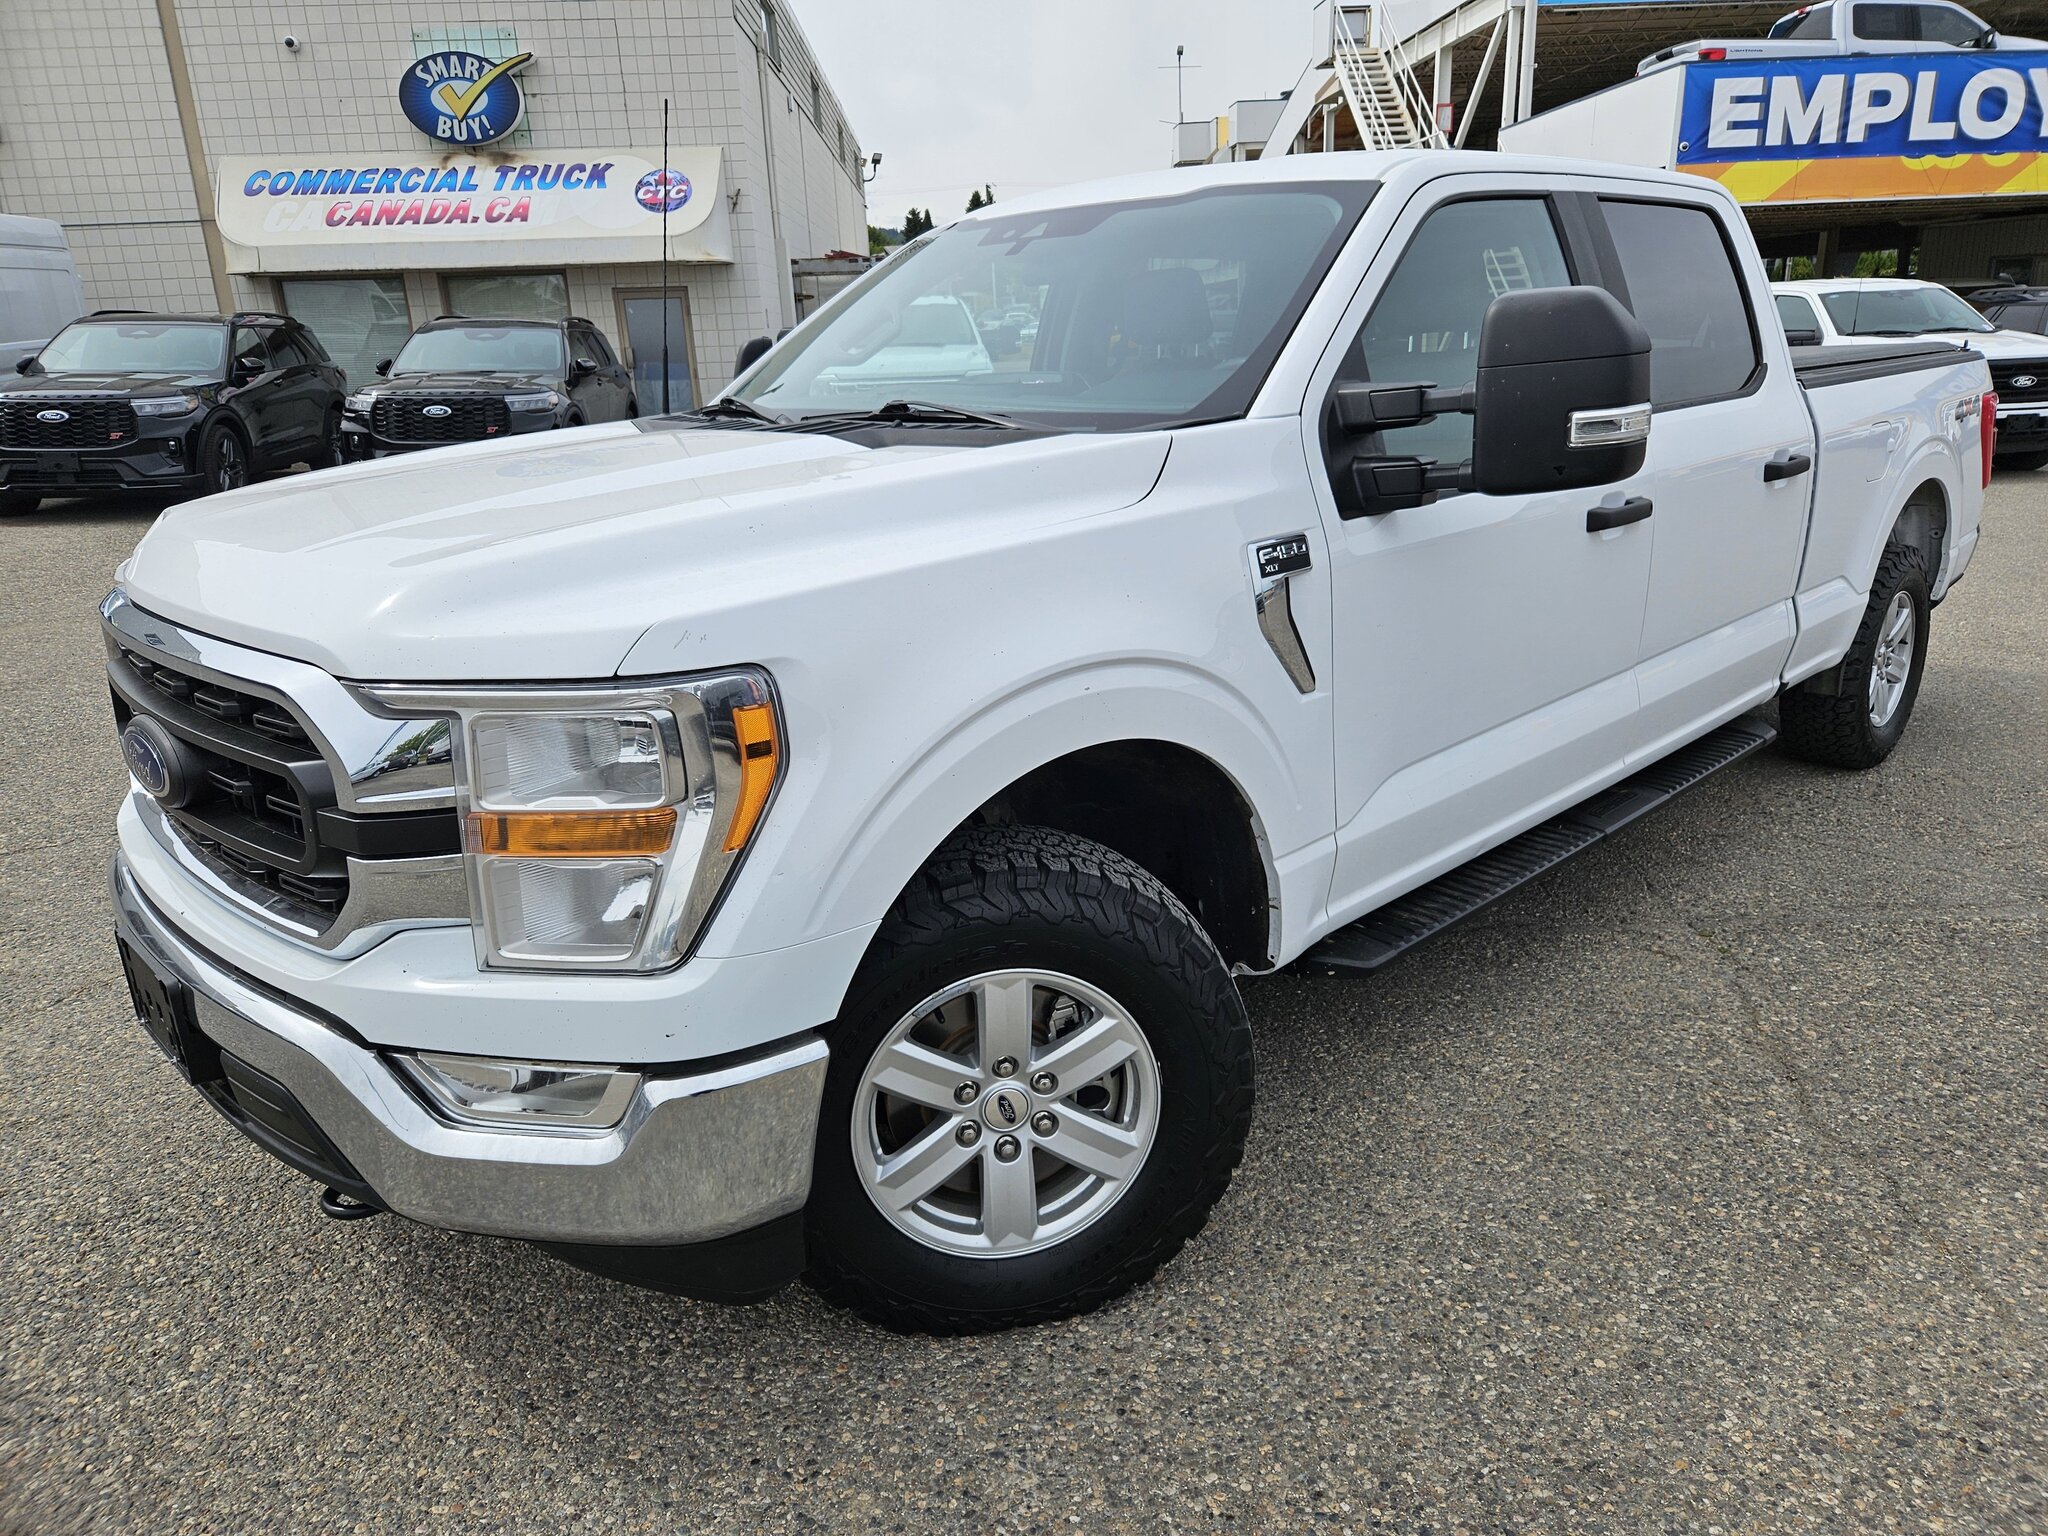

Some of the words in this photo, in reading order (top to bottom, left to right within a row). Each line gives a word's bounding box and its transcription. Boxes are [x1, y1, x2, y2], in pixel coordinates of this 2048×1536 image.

[415, 55, 494, 88] SMART
[436, 114, 495, 141] BUY!
[243, 165, 478, 197] COMMERCIAL
[493, 162, 615, 191] TRUCK
[637, 184, 688, 200] CTC
[325, 196, 532, 228] CANADA.CA
[2016, 375, 2033, 386] Ford
[109, 432, 124, 440] ST
[485, 426, 499, 434] ST
[1264, 563, 1279, 573] XLT
[128, 739, 154, 785] Ford
[1000, 1099, 1016, 1119] Ford
